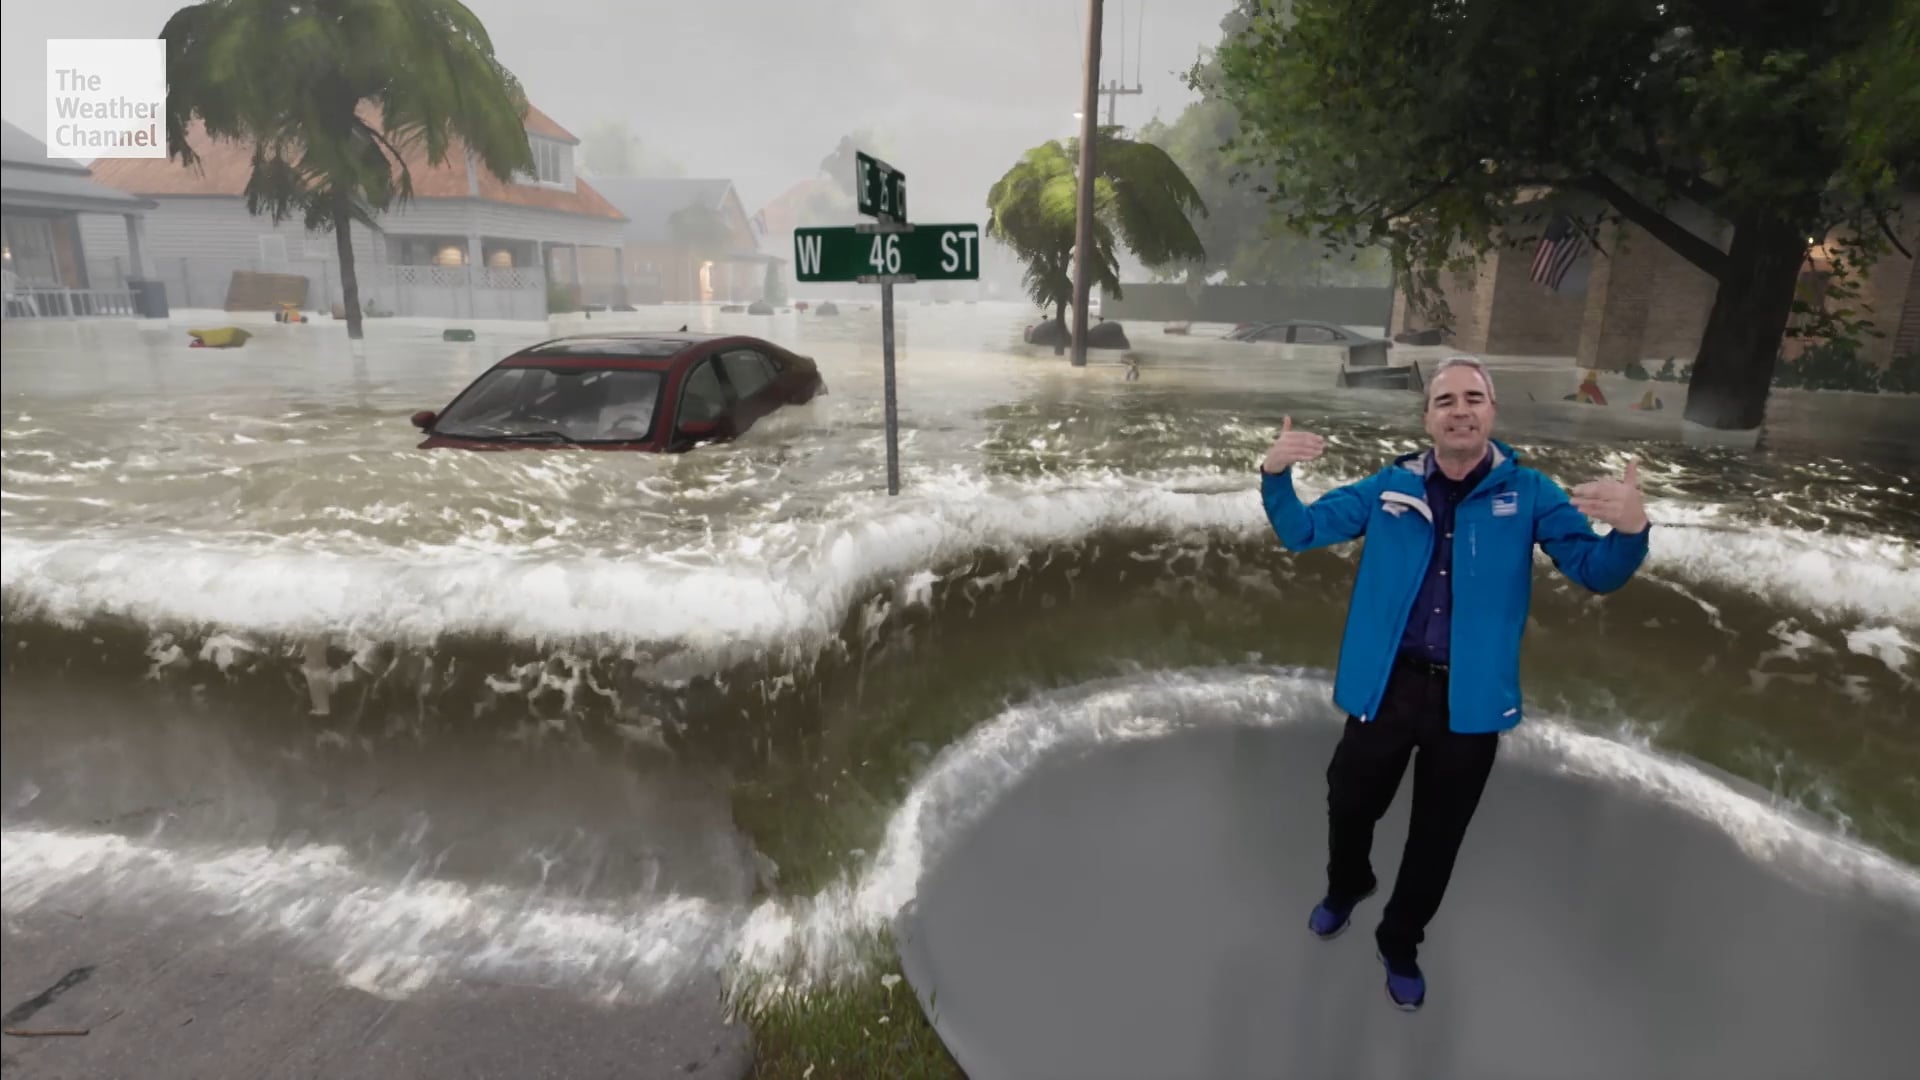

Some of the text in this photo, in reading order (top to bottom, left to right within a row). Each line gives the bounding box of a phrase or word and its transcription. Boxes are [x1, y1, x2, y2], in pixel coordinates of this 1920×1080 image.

[797, 231, 978, 275] W 46 ST
